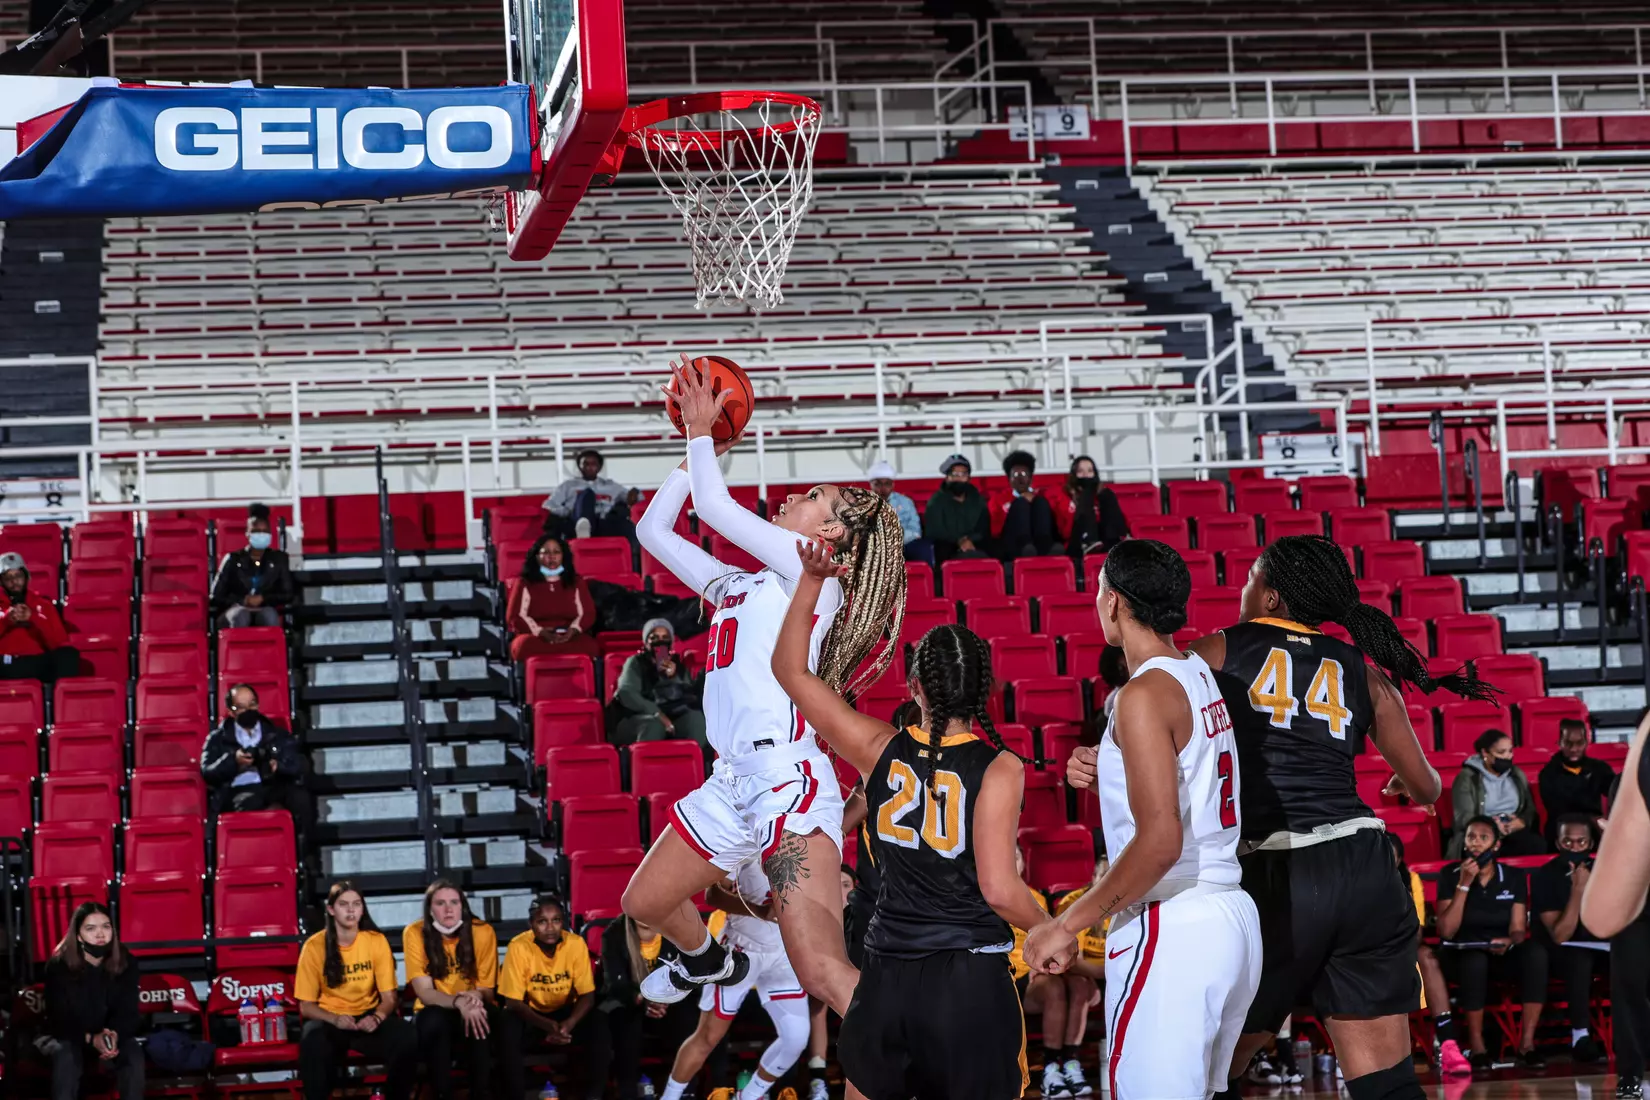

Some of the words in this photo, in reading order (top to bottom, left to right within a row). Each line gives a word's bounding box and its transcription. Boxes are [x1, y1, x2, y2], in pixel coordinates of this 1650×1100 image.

[154, 106, 512, 171] GEICO
[1061, 113, 1074, 131] 9
[40, 482, 65, 492] SEC
[705, 616, 738, 673] 20
[1247, 647, 1353, 741] 44
[877, 758, 967, 859] 20
[1217, 750, 1238, 830] 2
[139, 988, 186, 1003] OHN'S
